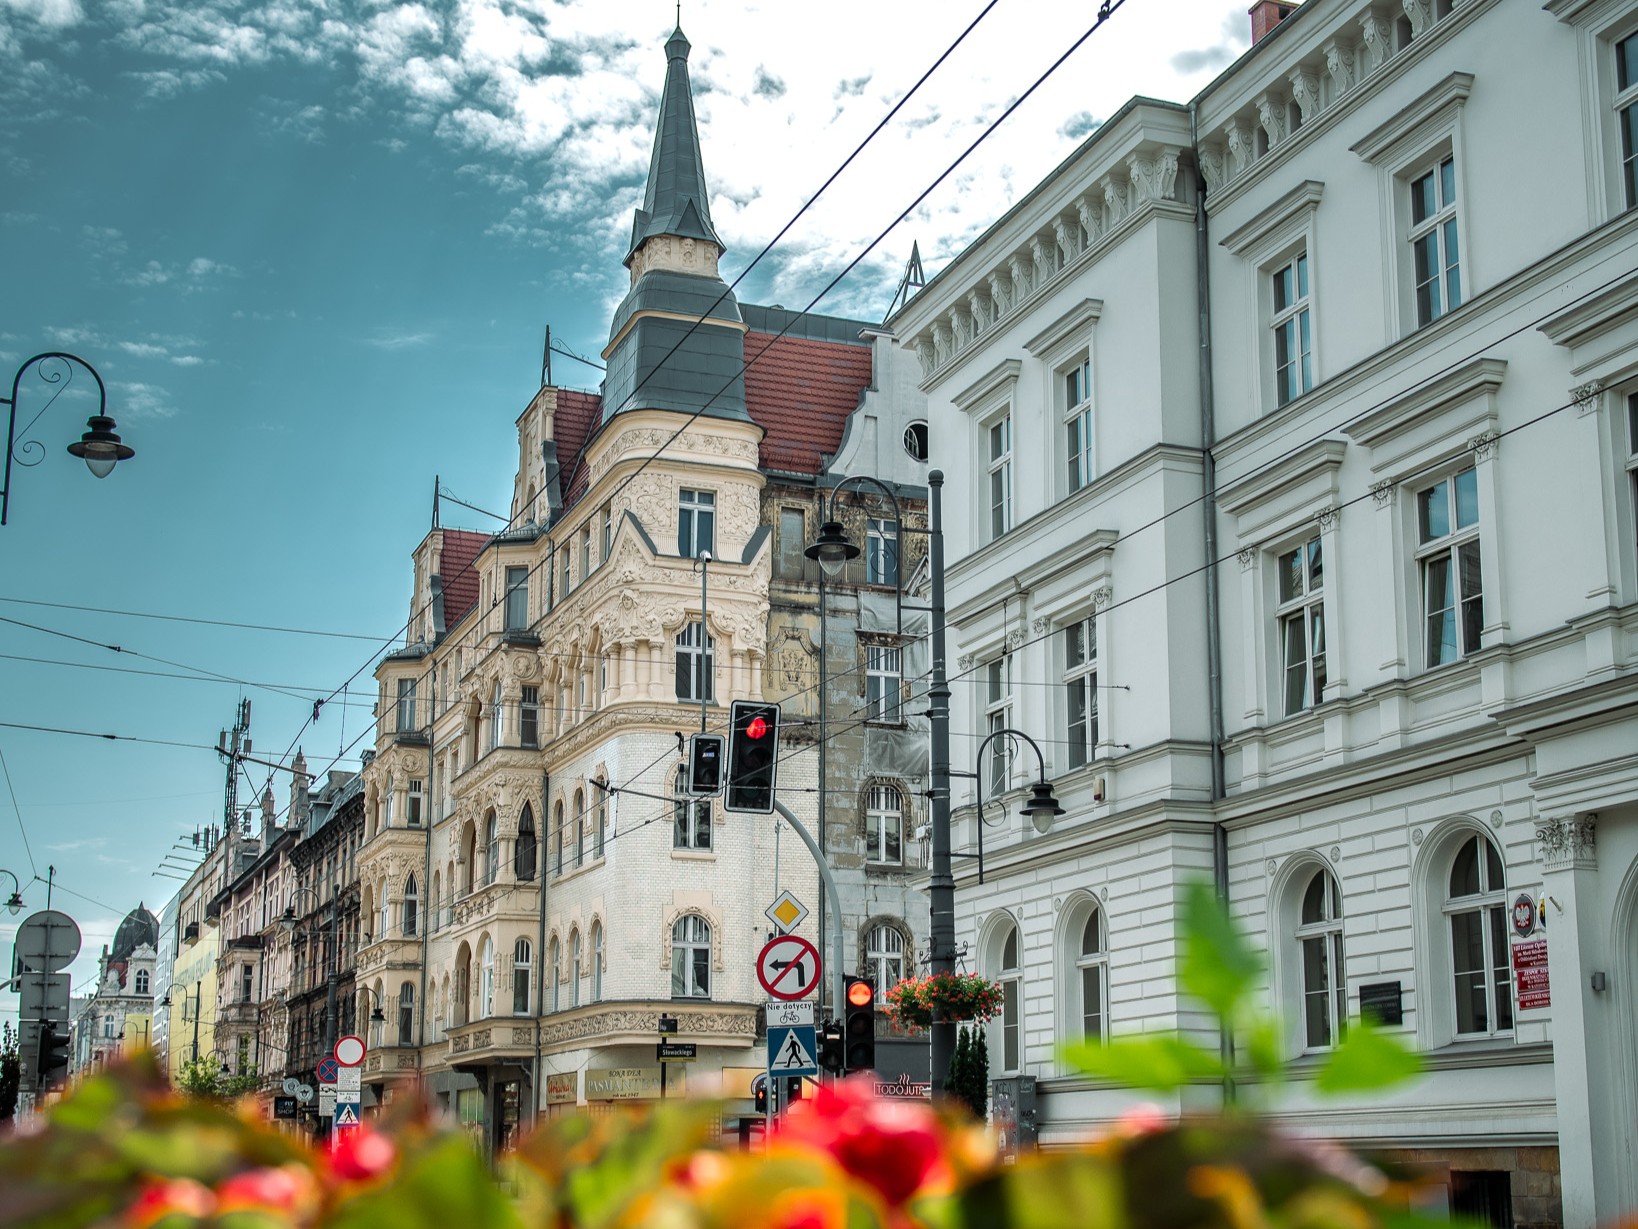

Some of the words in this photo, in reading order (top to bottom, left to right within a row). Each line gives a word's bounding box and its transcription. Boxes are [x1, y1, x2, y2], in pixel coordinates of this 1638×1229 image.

[783, 1002, 812, 1010] dotyczy
[588, 1077, 676, 1093] PASMANTERA
[877, 1085, 929, 1095] TODOJUTR
